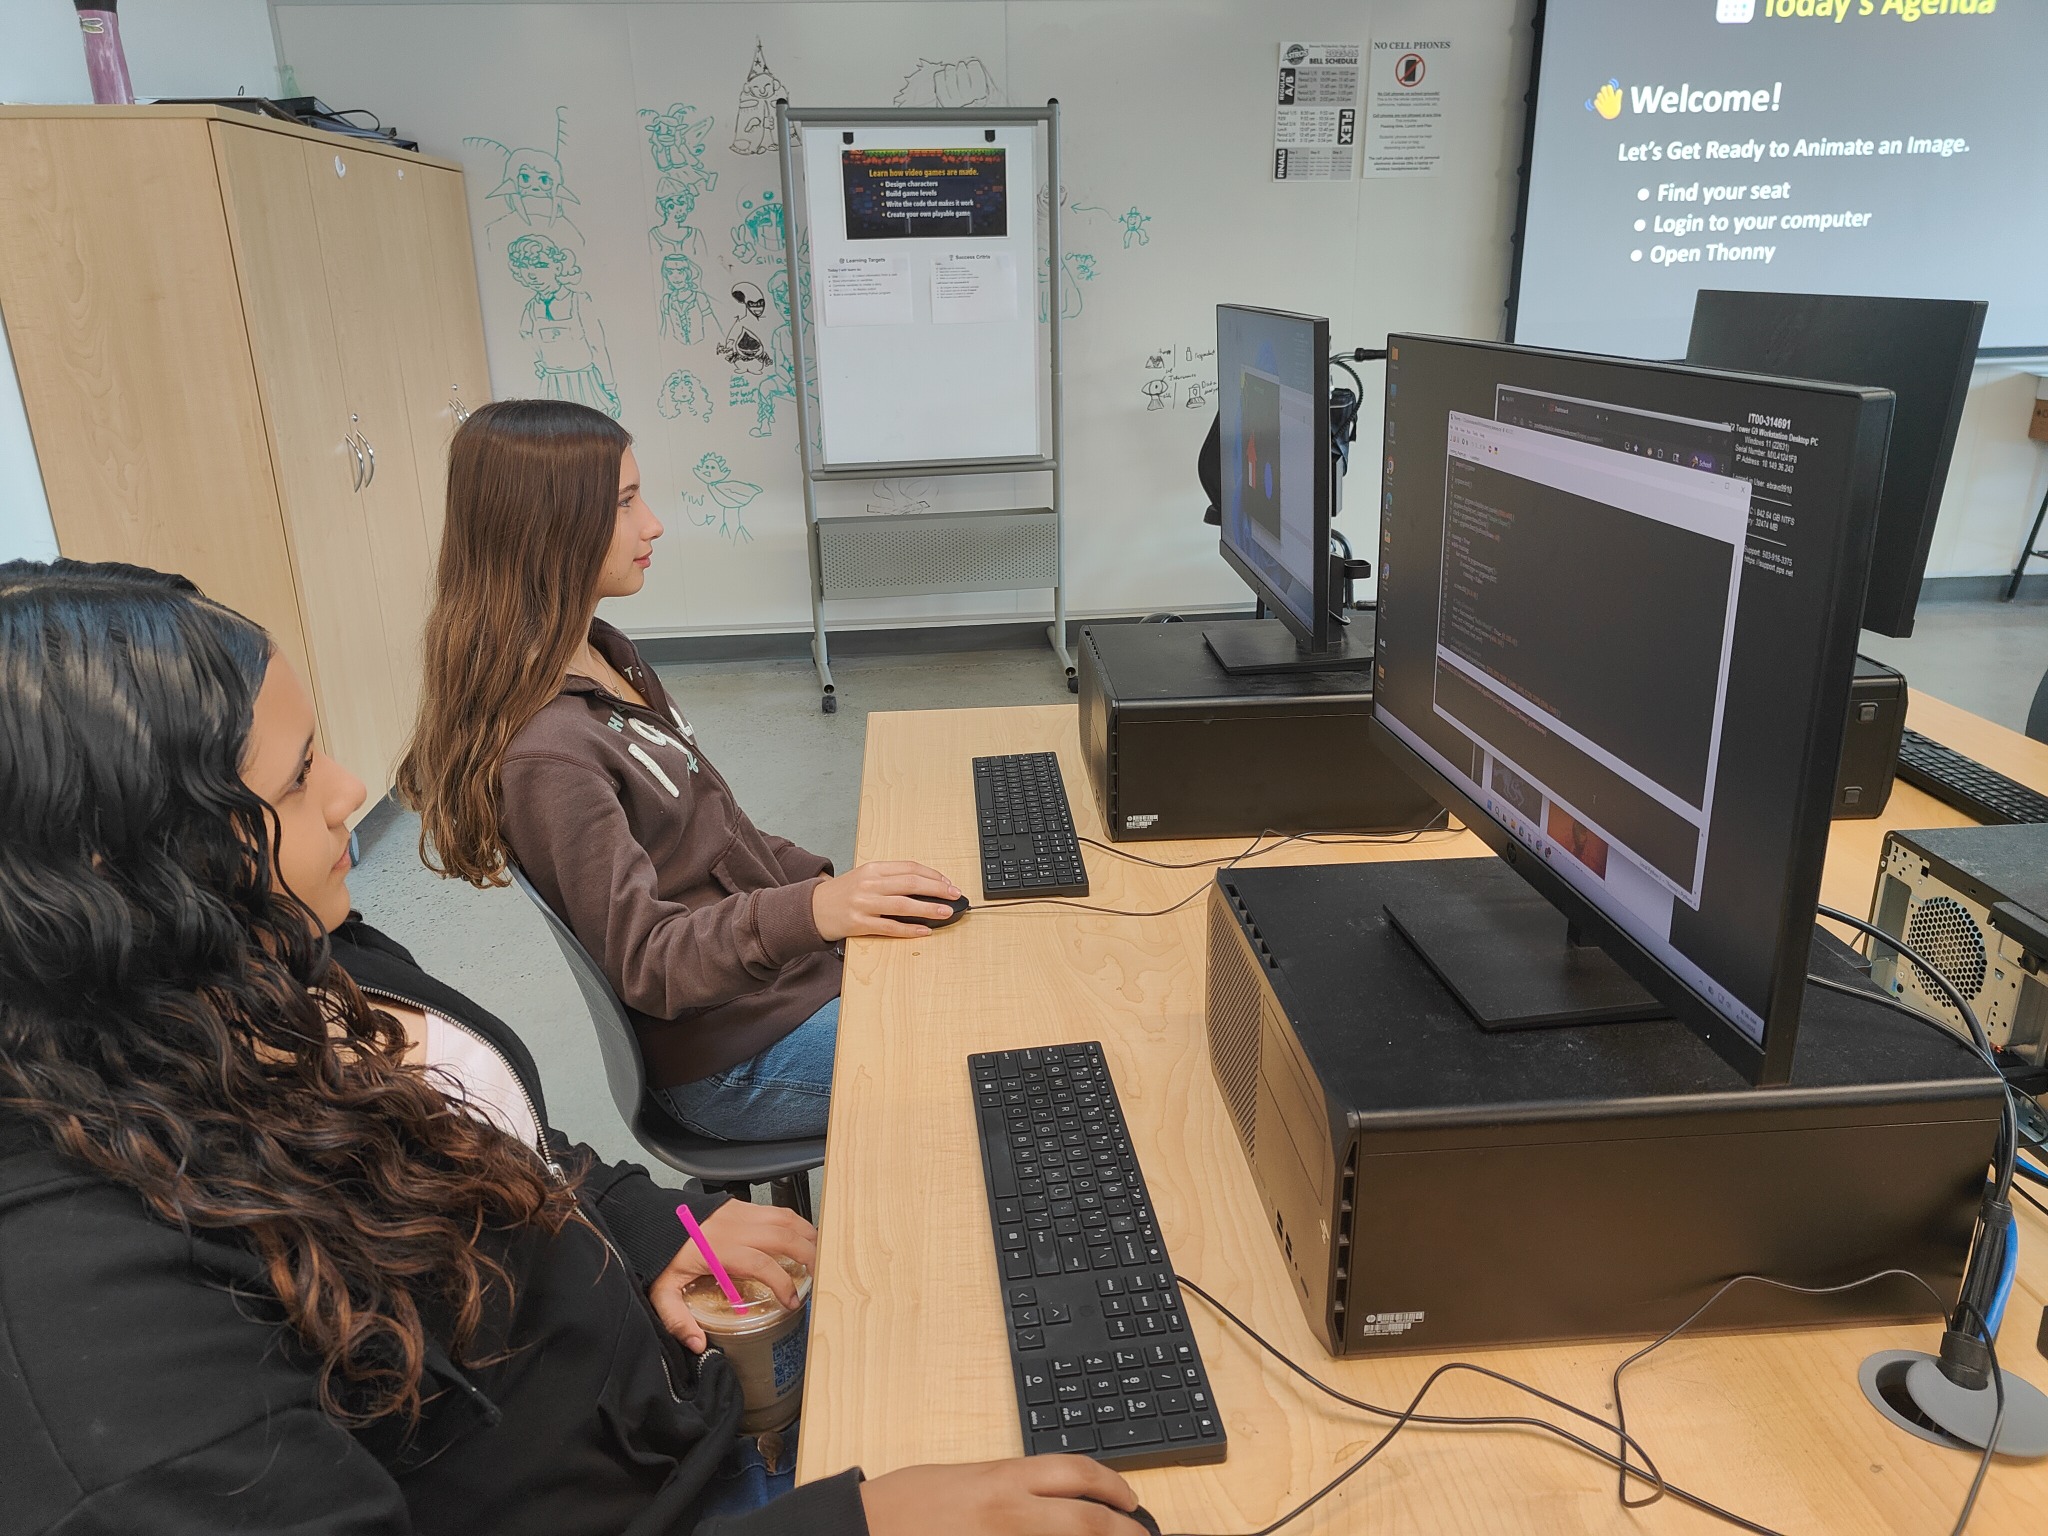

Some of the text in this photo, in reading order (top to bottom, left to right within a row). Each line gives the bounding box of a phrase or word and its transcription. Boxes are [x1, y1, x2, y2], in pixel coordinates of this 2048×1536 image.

[1765, 0, 1996, 23] Todays Agenda
[1374, 42, 1387, 50] NO
[1413, 41, 1451, 49] PHONES
[1285, 76, 1295, 97] A/B
[1631, 82, 1782, 113] Welcome!
[1342, 111, 1353, 144] FLEX
[1618, 136, 1970, 162] Let's Get Ready to Animate an Image.
[869, 169, 888, 177] Learn
[889, 169, 904, 177] how
[905, 169, 922, 177] video
[924, 169, 945, 178] games
[959, 168, 979, 176] made.
[1277, 149, 1286, 178] FINALS
[1658, 182, 1791, 205] Find your seat
[932, 210, 954, 218] playable
[1654, 210, 1872, 236] Login to your computer
[1650, 242, 1776, 267] Open Thonny
[1748, 413, 1791, 430] IT00-314691
[1736, 424, 1751, 434] Tower
[1759, 428, 1788, 441] Workstation
[1789, 434, 1809, 446] Desktop
[1810, 437, 1819, 446] PC
[1744, 436, 1765, 447] Windows
[1735, 444, 1747, 453] Serial
[1770, 522, 1778, 531] MB
[1781, 515, 1795, 526] NTFS
